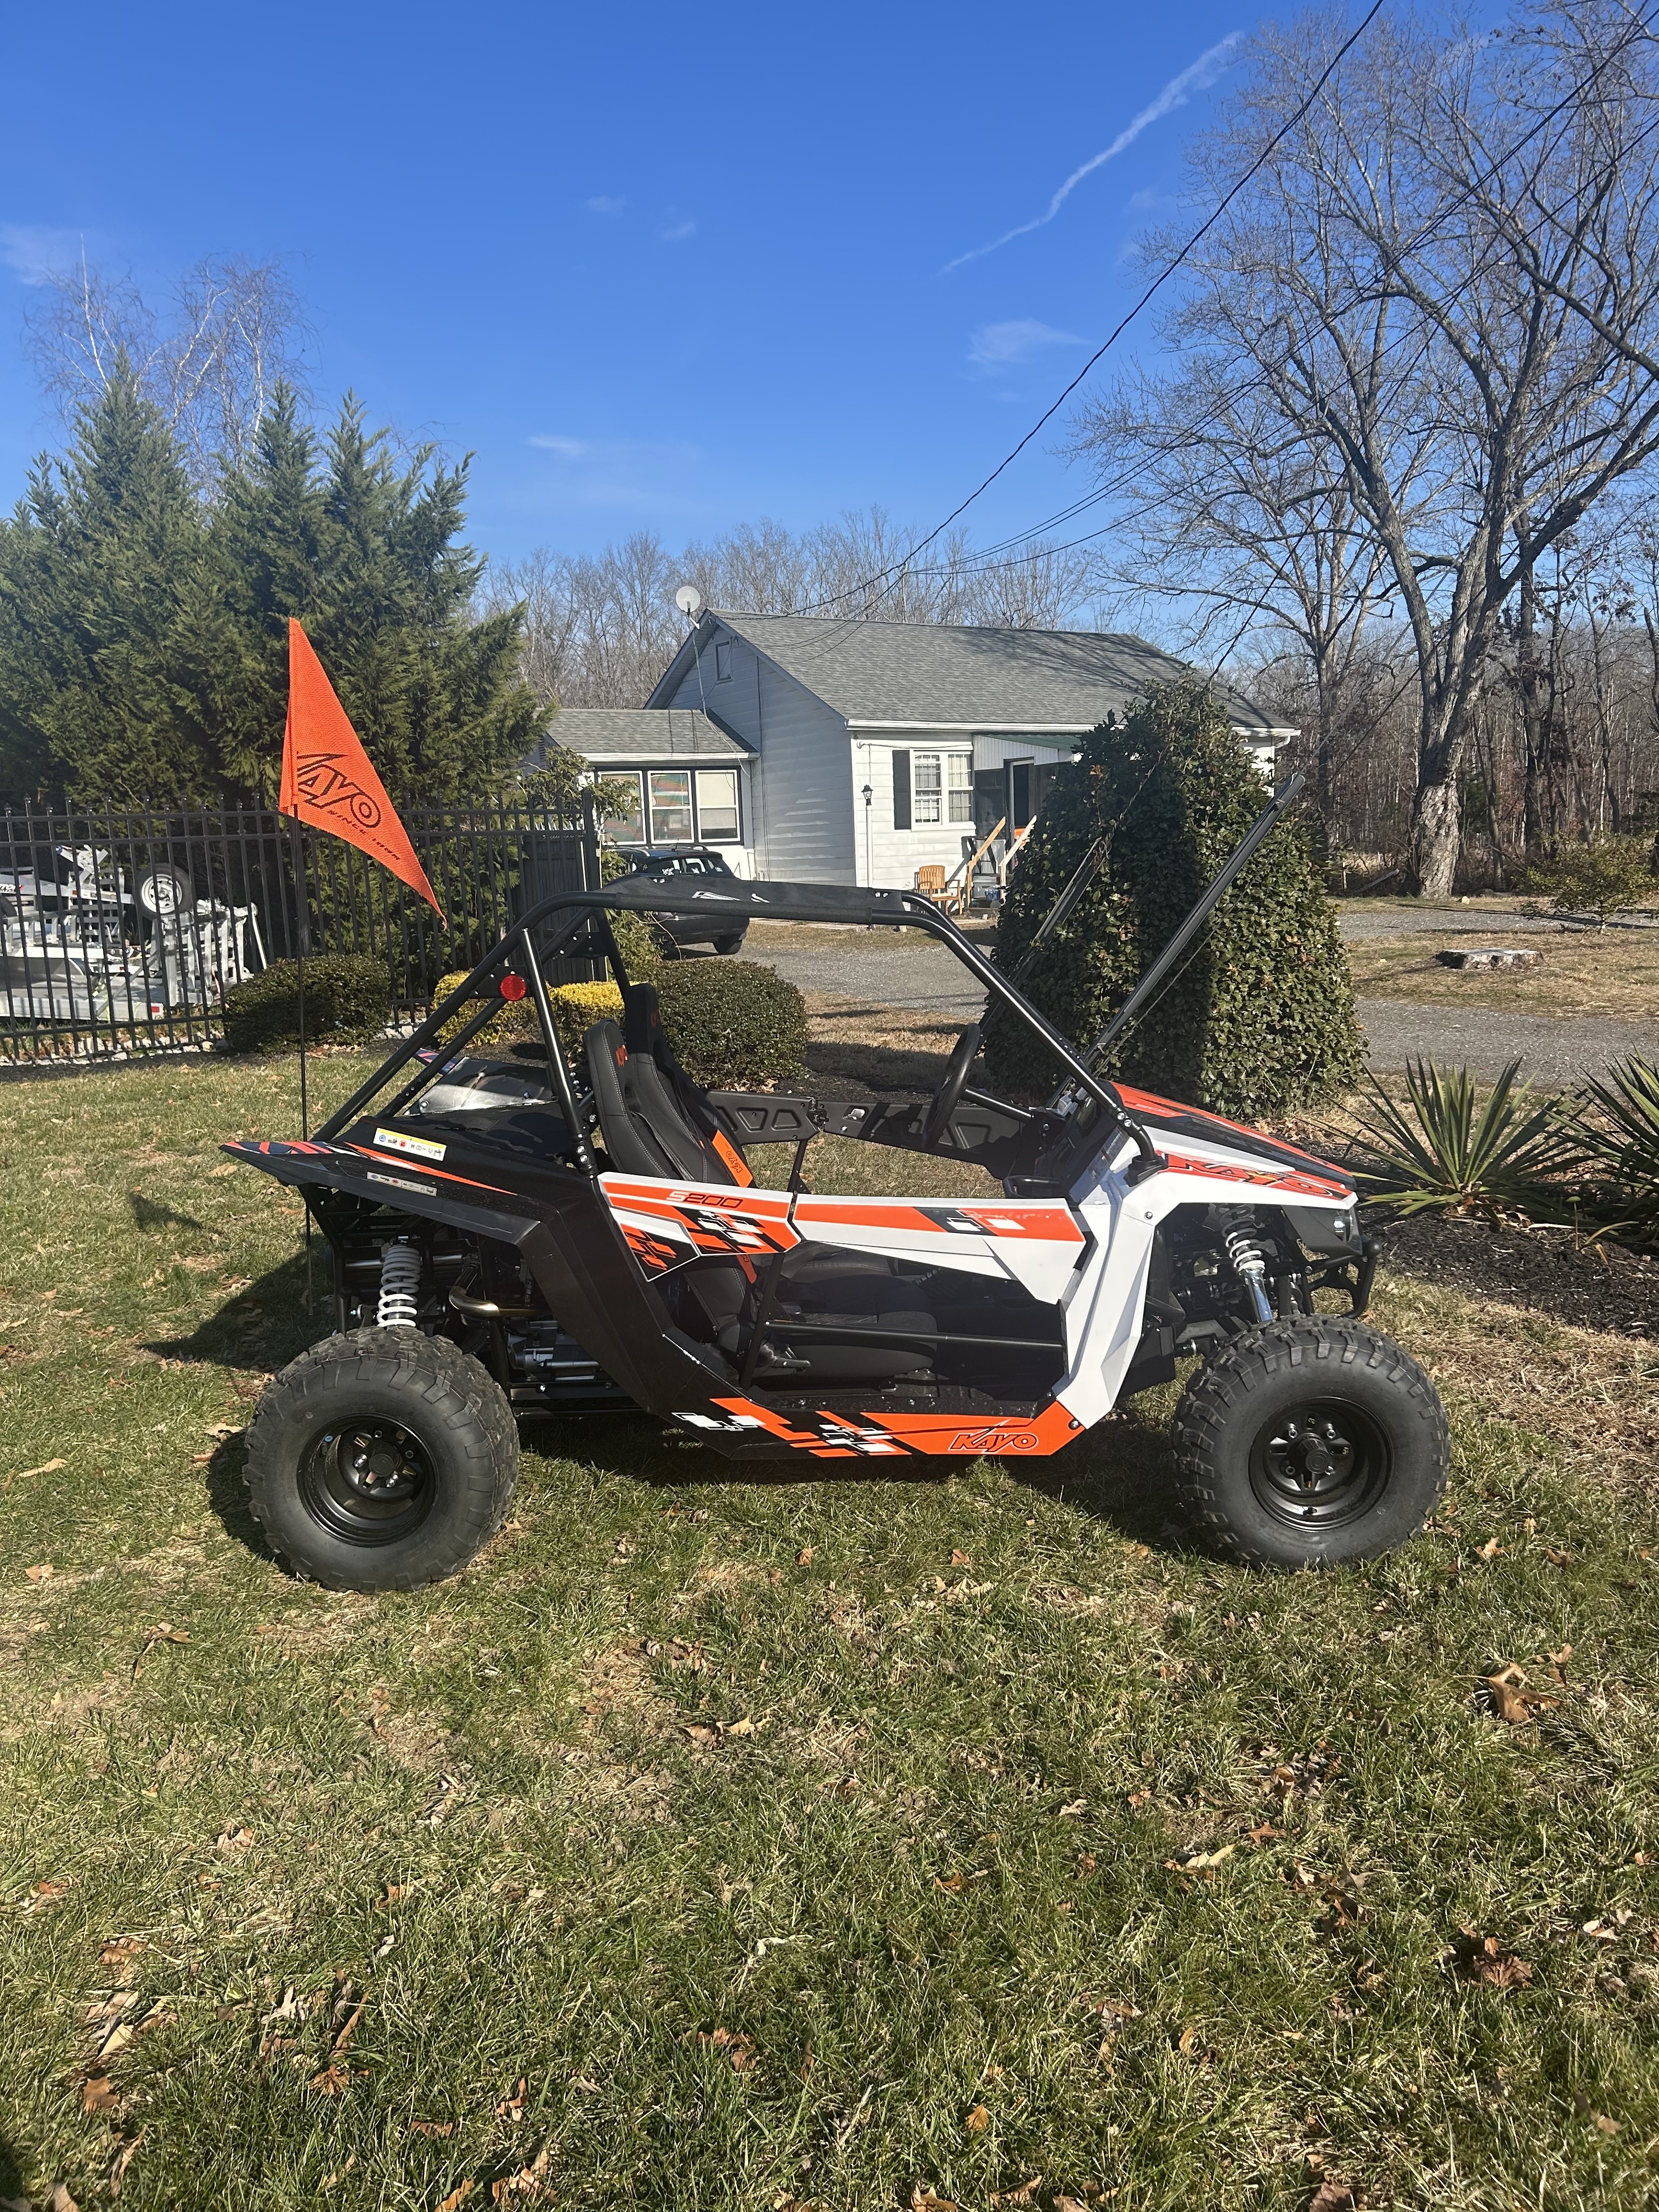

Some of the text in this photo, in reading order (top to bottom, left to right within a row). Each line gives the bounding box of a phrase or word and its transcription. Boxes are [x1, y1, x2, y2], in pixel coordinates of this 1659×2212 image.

[1184, 1157, 1334, 1197] KAYO
[665, 1190, 743, 1209] S200
[947, 1422, 1039, 1454] KAYO
